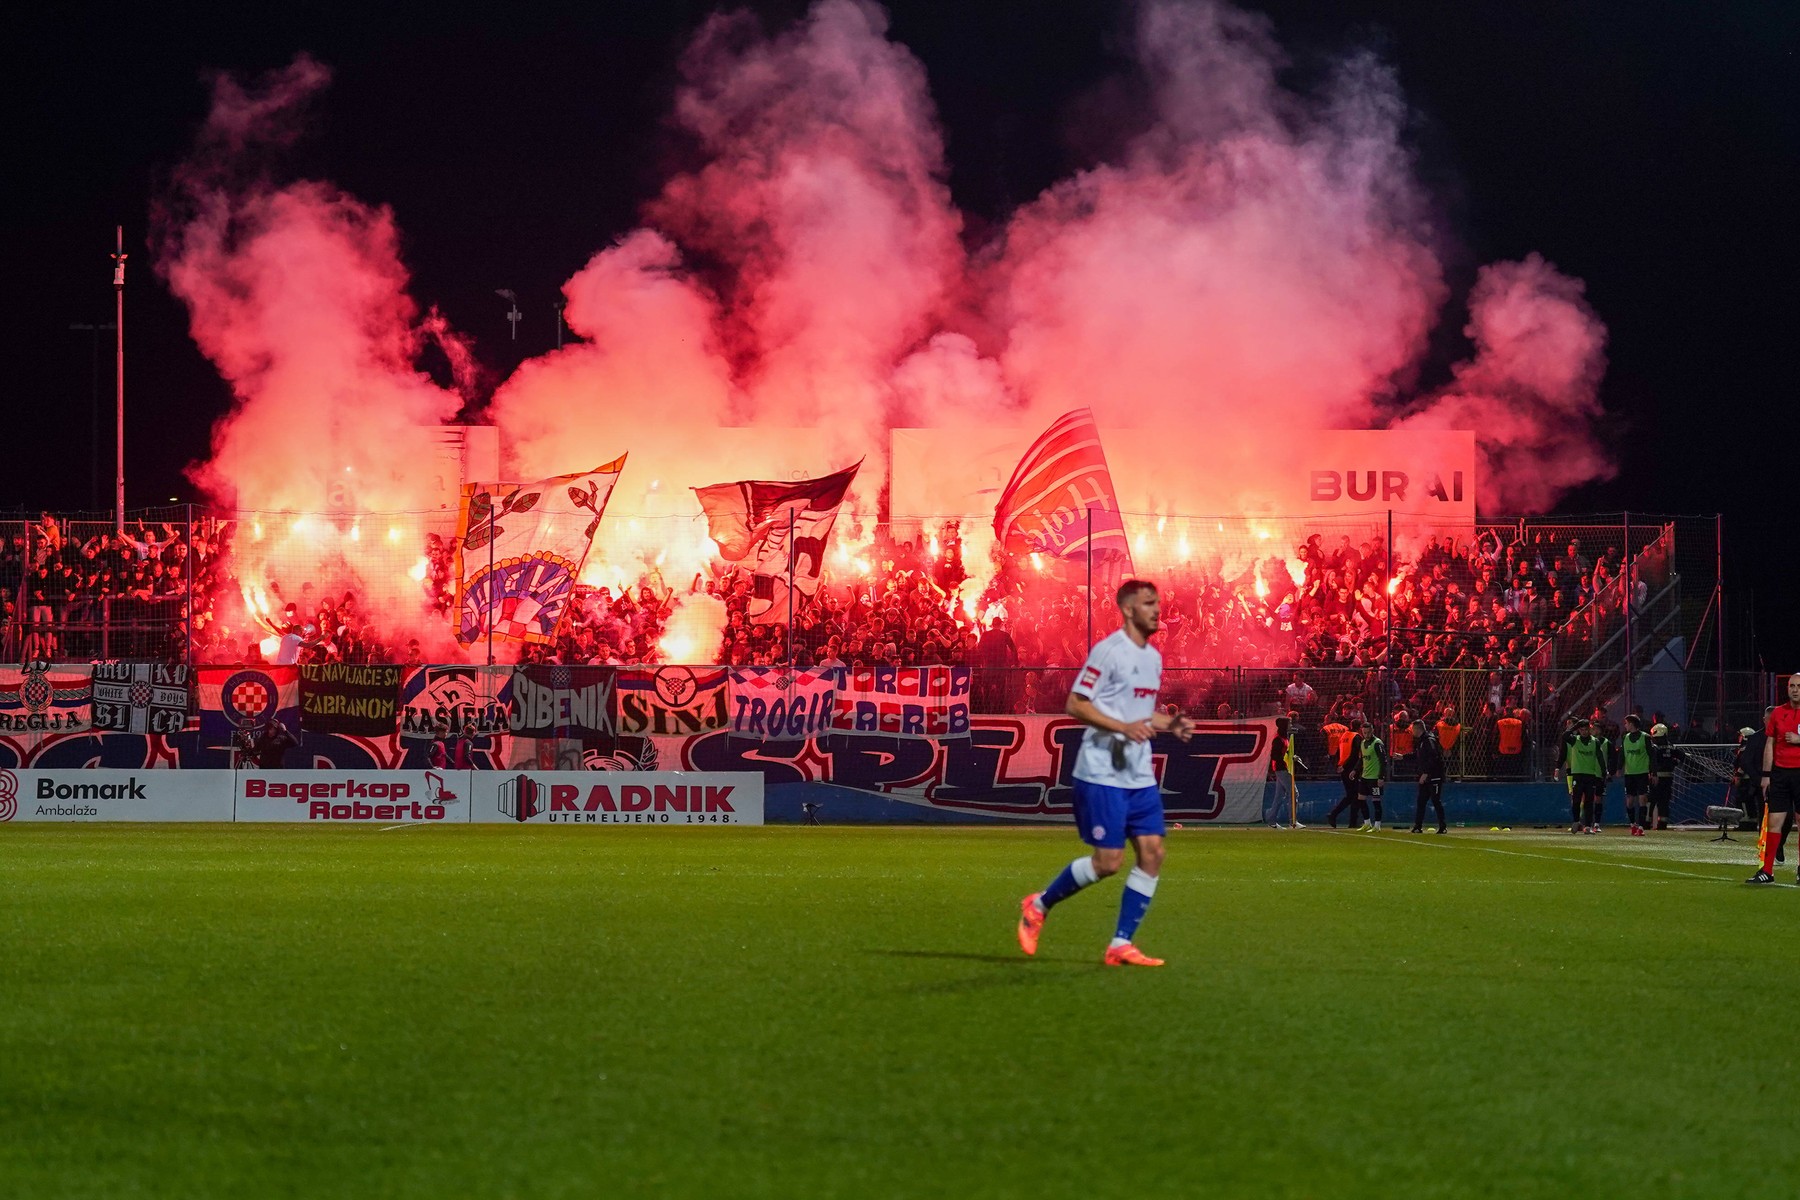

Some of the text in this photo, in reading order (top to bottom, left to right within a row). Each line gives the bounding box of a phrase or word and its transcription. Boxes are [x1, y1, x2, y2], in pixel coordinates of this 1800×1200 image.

[322, 664, 382, 686] NAVIJAČE
[384, 668, 399, 687] SA
[833, 666, 970, 697] TORCIDA
[160, 691, 185, 705] BOYS
[304, 692, 395, 720] ZABRANOM
[510, 665, 616, 737] ŠIBENIK
[622, 687, 727, 735] SINJ
[735, 689, 834, 737] TROGIR
[831, 699, 969, 735] ZAGREB
[37, 777, 147, 800] Bomark
[246, 779, 410, 803] Bagerkop
[549, 785, 736, 813] RADNIK
[36, 805, 97, 817] Ambalaža
[310, 801, 445, 821] Roberto
[549, 814, 738, 824] UTEMELJENO 1948.
